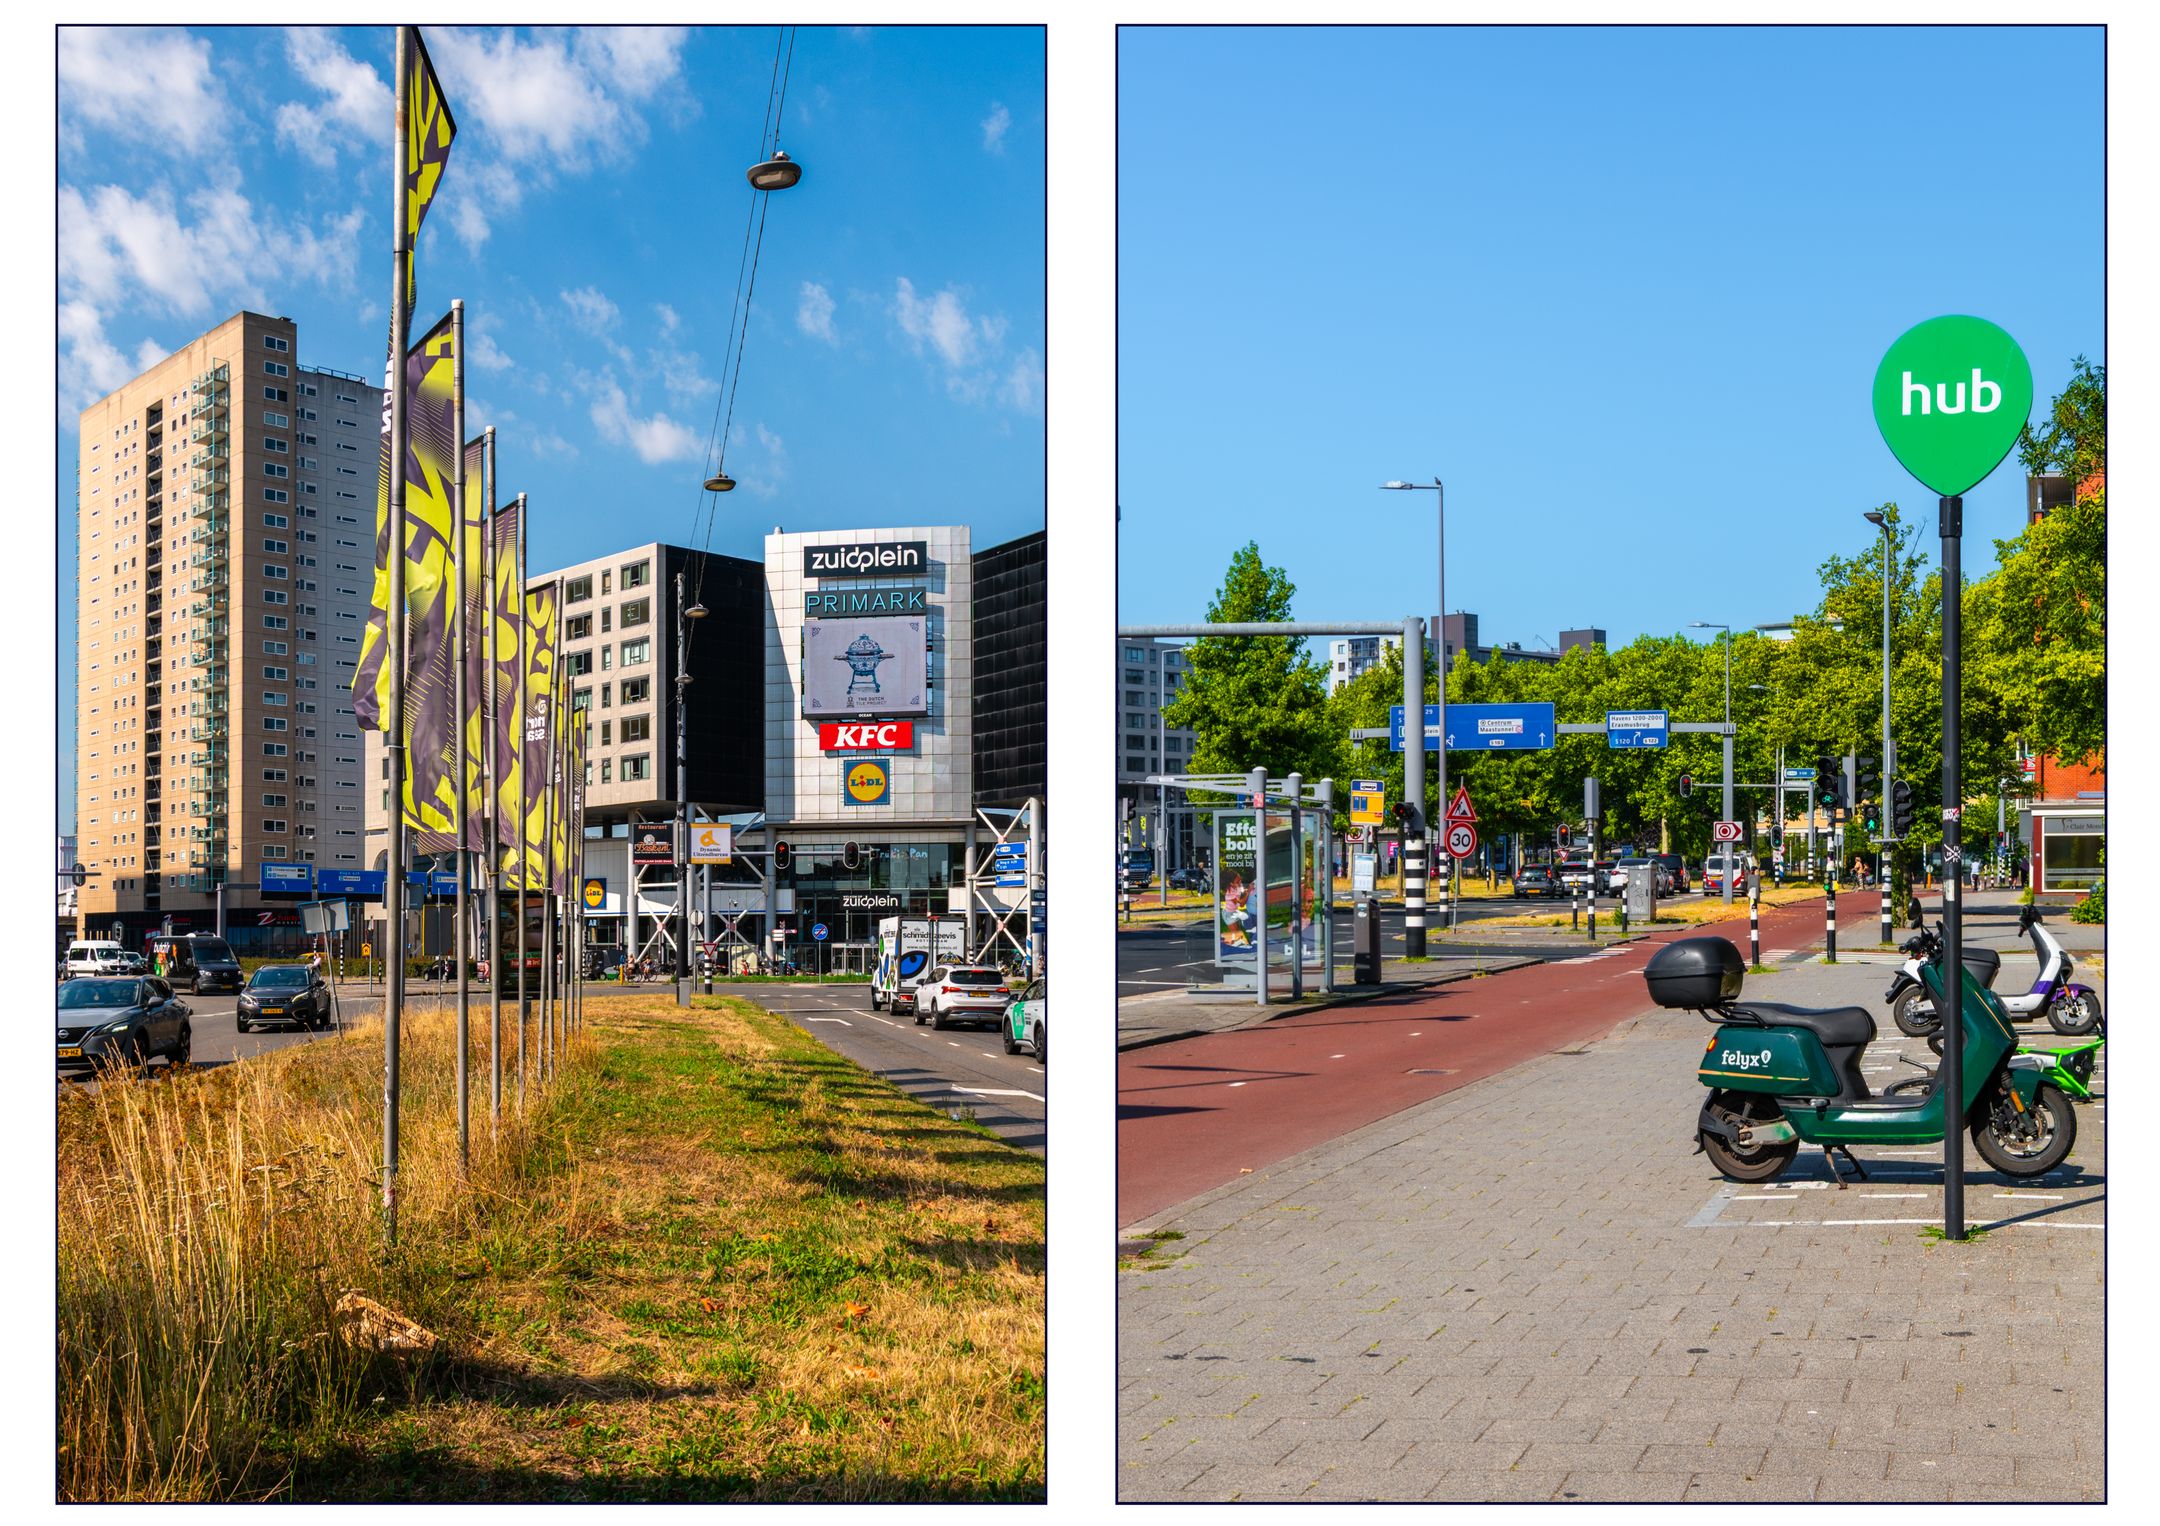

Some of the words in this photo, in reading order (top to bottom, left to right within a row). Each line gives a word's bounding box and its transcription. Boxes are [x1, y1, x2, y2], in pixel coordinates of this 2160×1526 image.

[1902, 368, 2002, 415] hub
[812, 545, 918, 572] zuidplein
[807, 591, 924, 613] PRIMARK
[834, 725, 897, 747] KFC
[1226, 837, 1257, 850] boll
[1452, 833, 1471, 847] 30
[1236, 852, 1243, 860] je
[1245, 860, 1254, 868] bij
[843, 895, 899, 909] zuidplein
[1284, 944, 1311, 956] bl.
[1721, 1050, 1760, 1070] felyx
